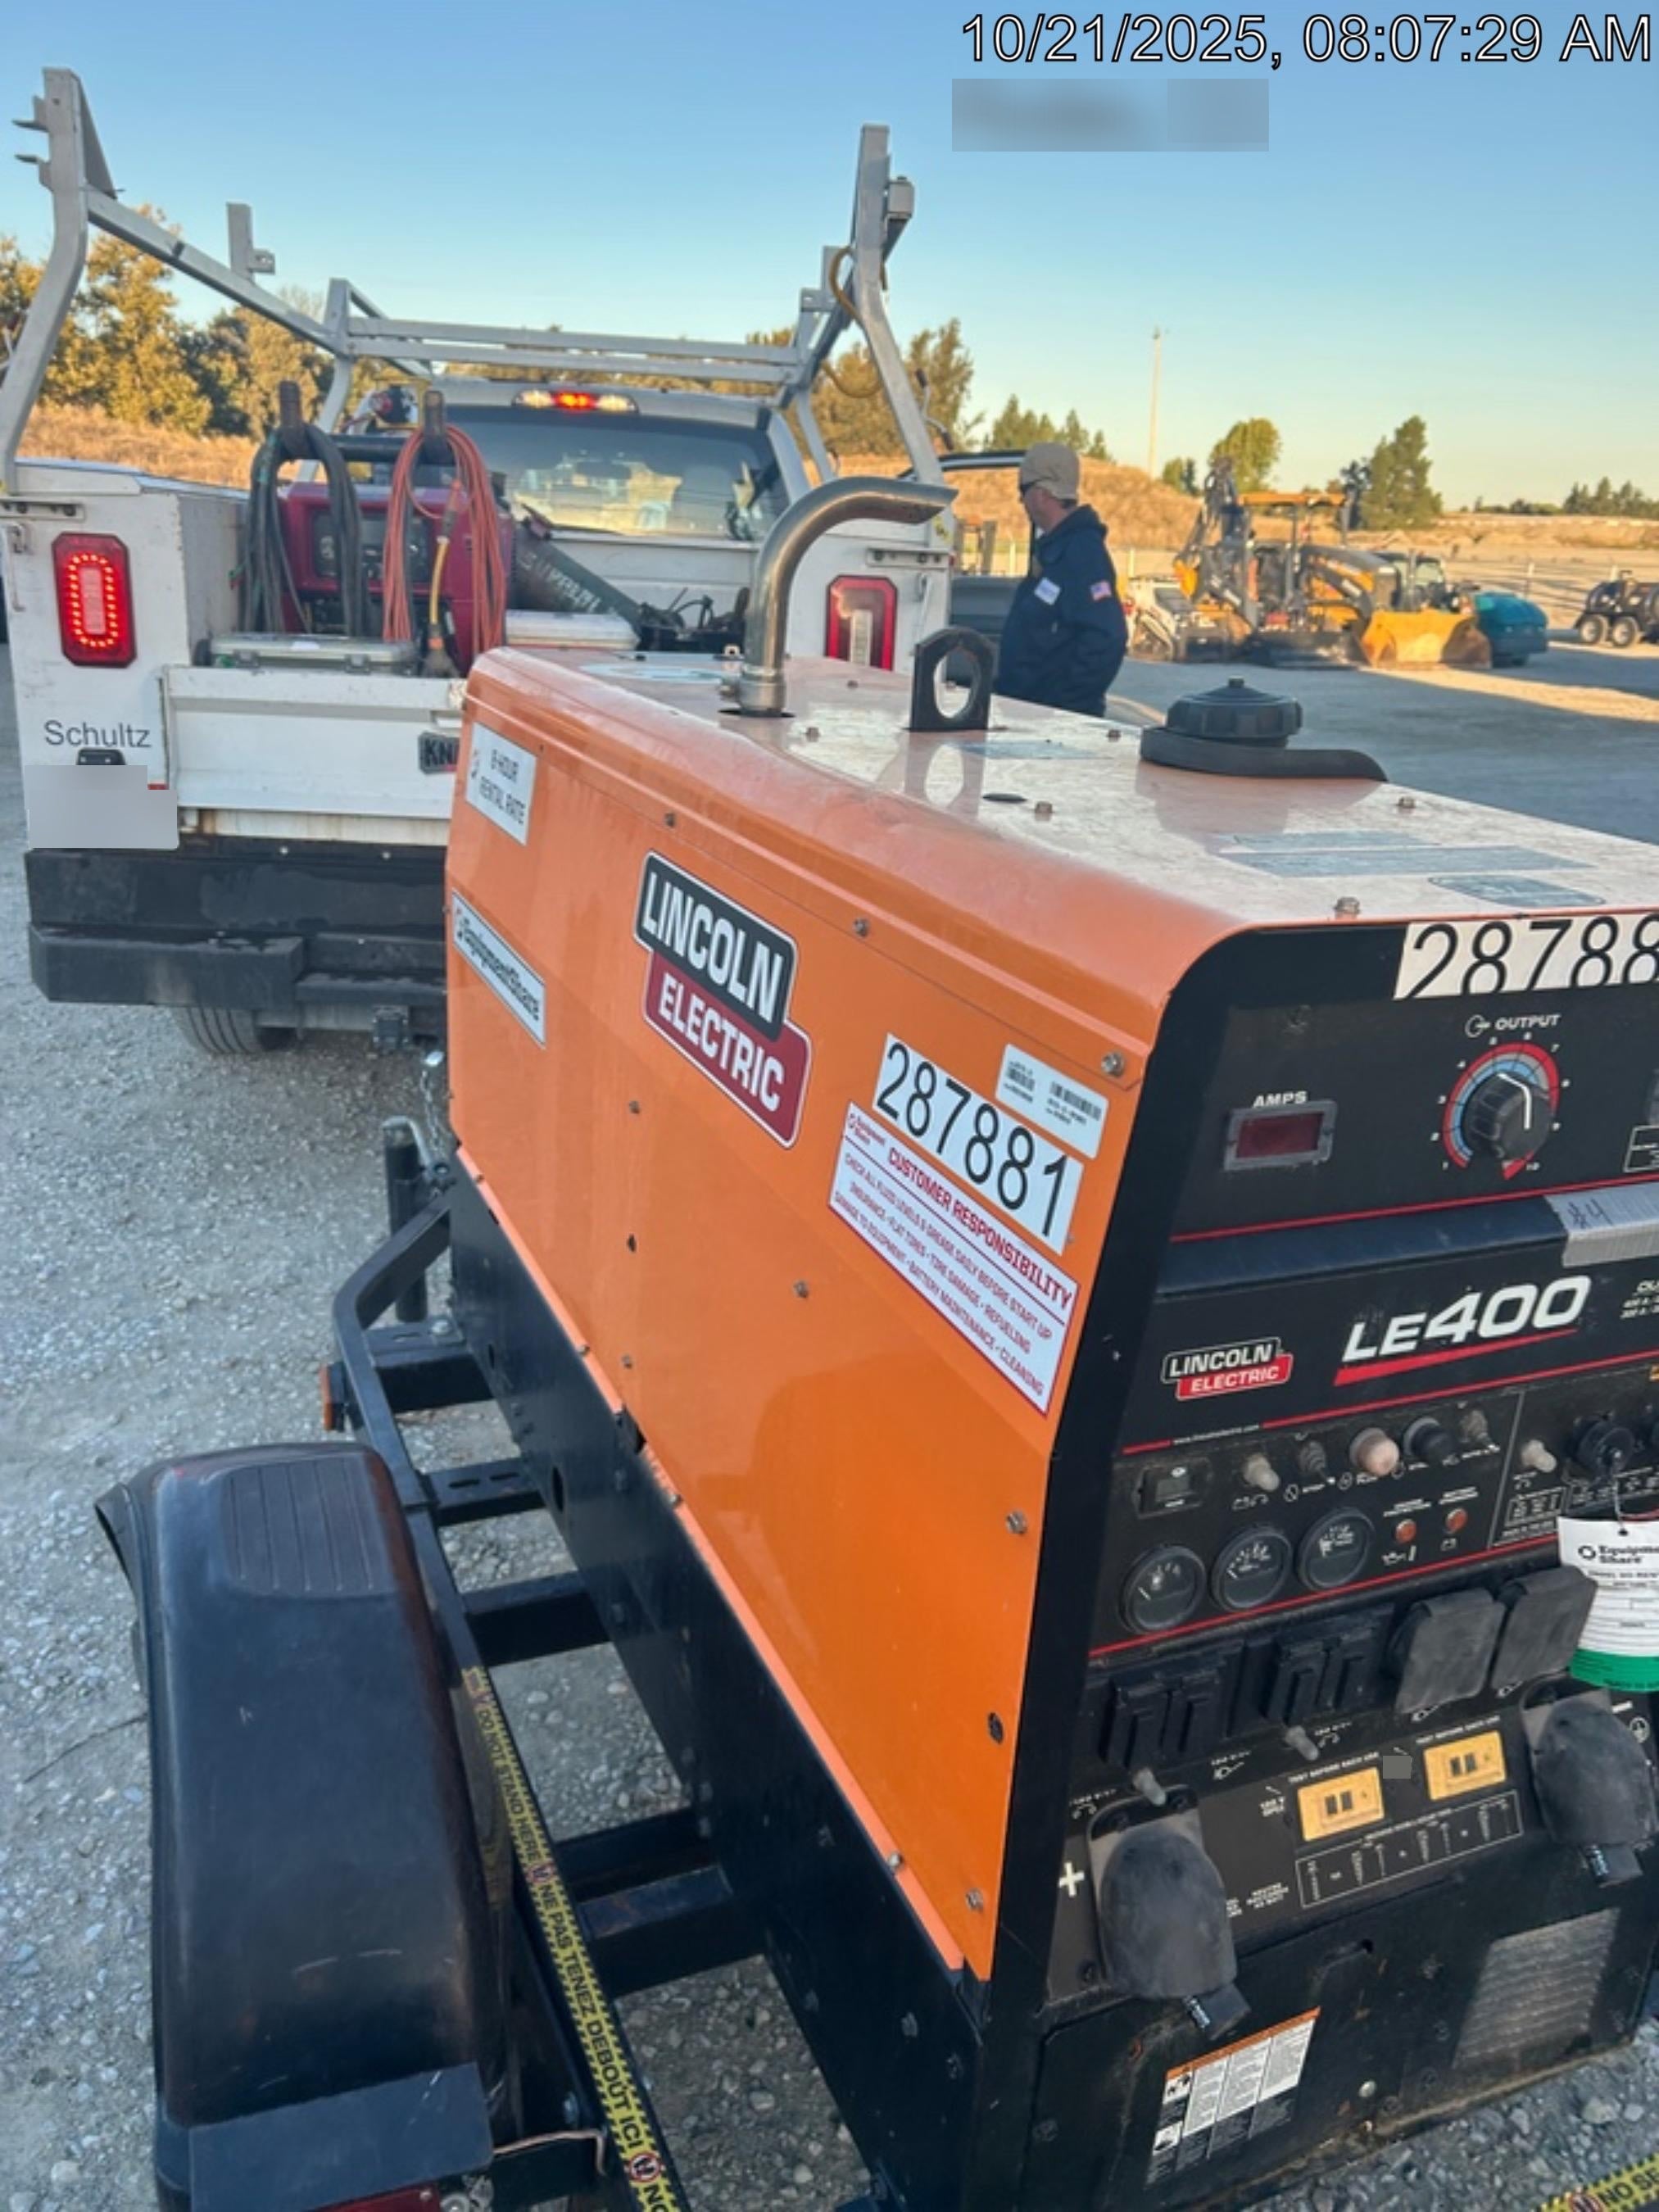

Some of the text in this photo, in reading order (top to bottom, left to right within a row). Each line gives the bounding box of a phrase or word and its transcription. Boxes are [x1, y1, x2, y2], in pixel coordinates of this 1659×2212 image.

[44, 720, 151, 749] Schultz
[424, 737, 460, 767] KN
[642, 873, 784, 1023] LINCOLN
[1494, 1013, 1562, 1031] OUTPUT
[658, 972, 785, 1113] ELECTRIC
[1253, 1090, 1308, 1108] AMPS
[877, 1042, 1069, 1238] 287881
[887, 1145, 1072, 1314] CUSTOMER RESPONSIBILITY
[1343, 1275, 1592, 1363] LE400
[1169, 1343, 1273, 1378] LINCOLN
[1190, 1366, 1279, 1394] ELECTRIC
[538, 1884, 558, 1910] NE
[550, 1911, 573, 1950] PAS
[563, 1951, 597, 2019] TENEZ
[620, 2116, 643, 2149] ICI
[1598, 2183, 1634, 2207] NO
